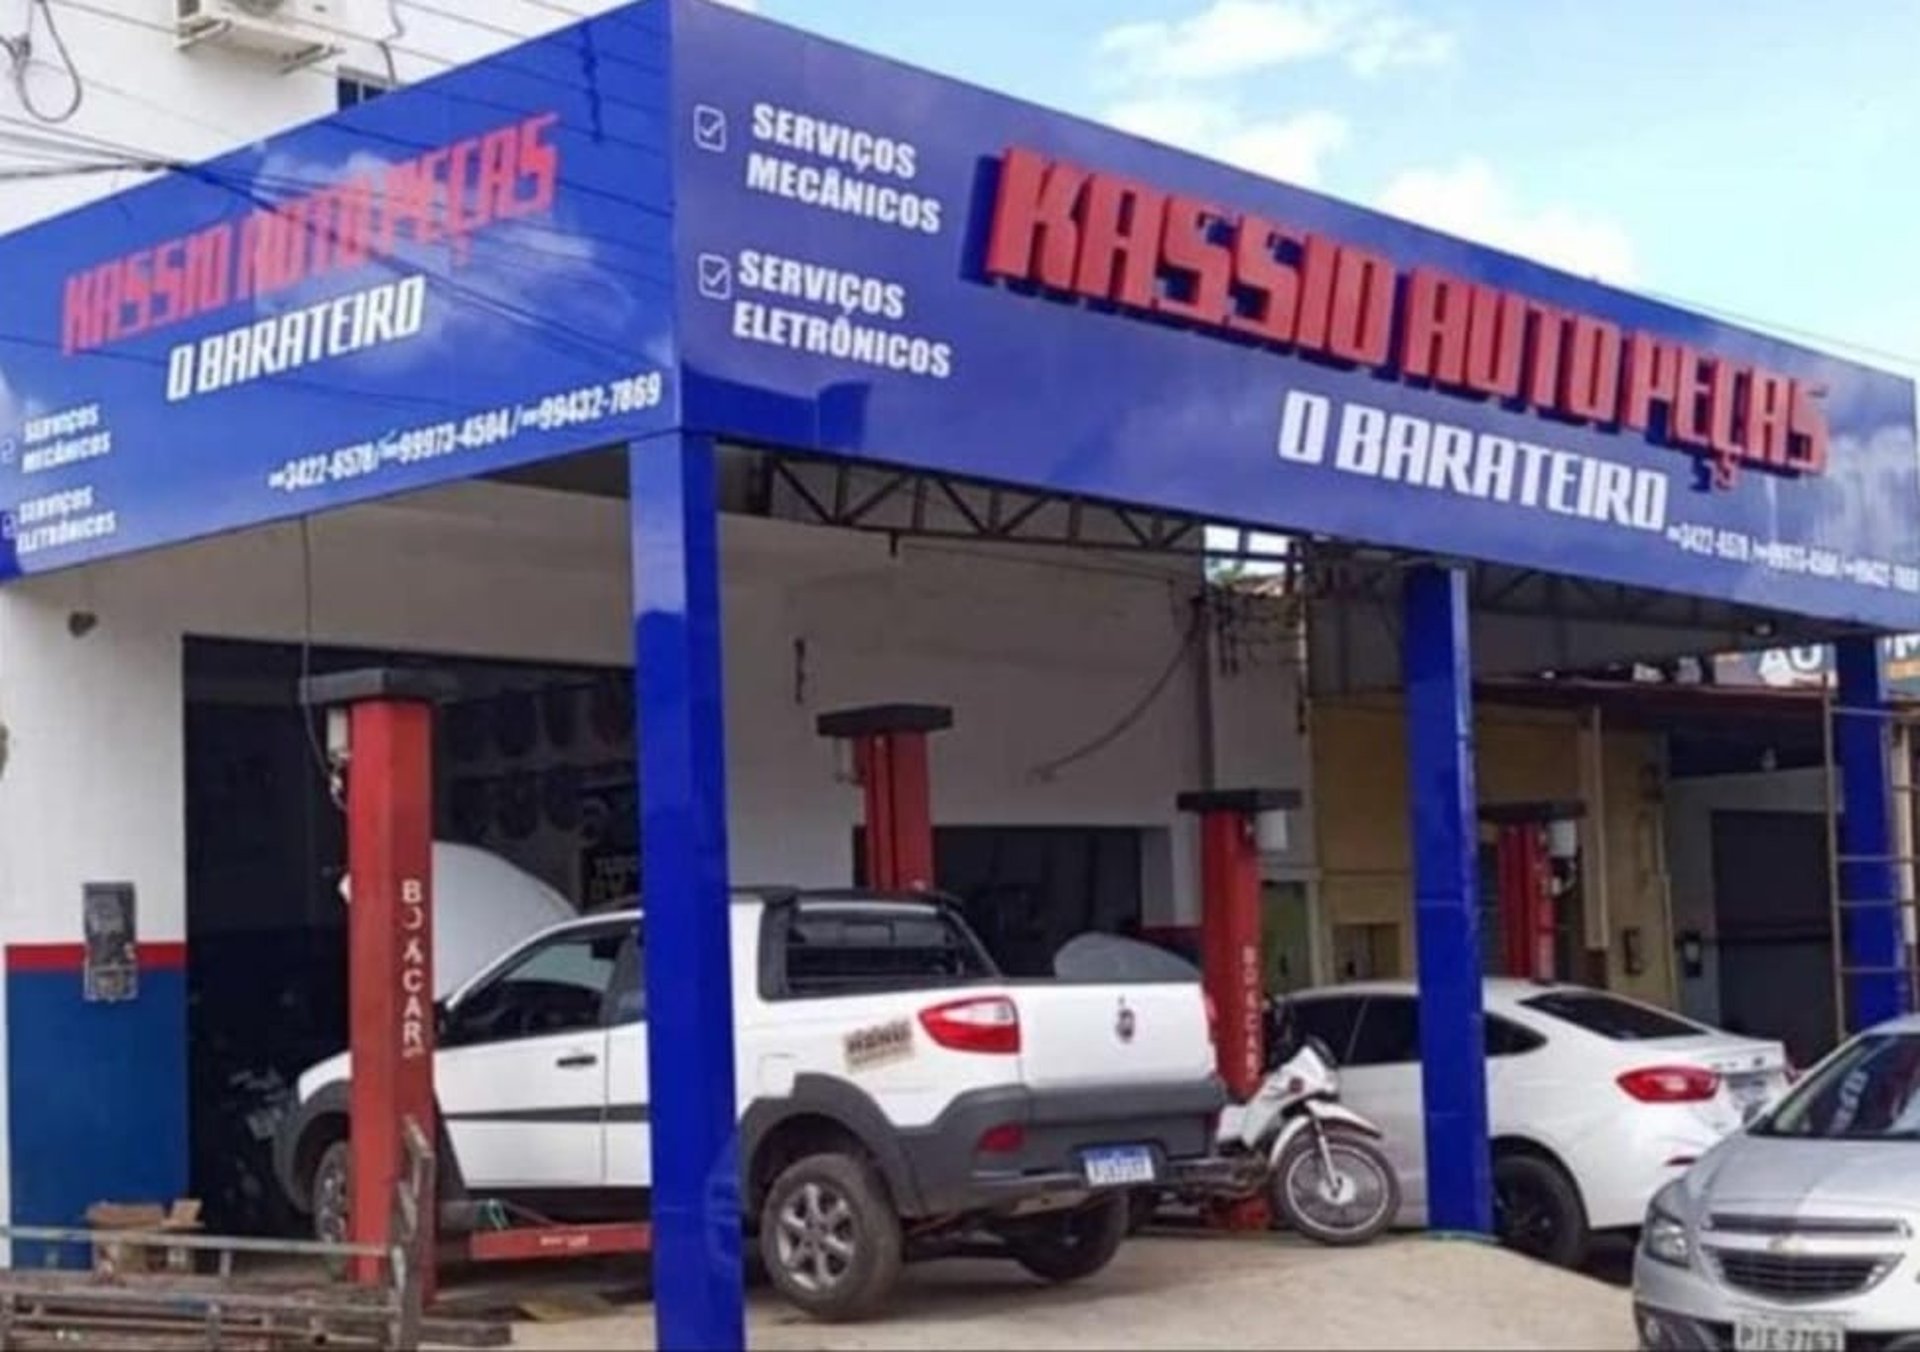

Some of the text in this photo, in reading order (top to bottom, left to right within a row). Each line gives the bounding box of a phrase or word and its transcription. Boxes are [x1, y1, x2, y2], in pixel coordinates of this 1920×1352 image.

[746, 153, 941, 233] MECÂNICOS
[752, 104, 917, 179] SERVIÇOS
[61, 223, 232, 357] KASSIO
[237, 174, 378, 300] AUTO
[738, 250, 905, 319] SERVIÇOS
[167, 275, 427, 401] O BARATEIRO
[733, 302, 952, 378] ELETRÔNICOS
[984, 147, 1831, 492] KASSIO AUTO PEÇAS
[1278, 390, 1668, 531] O BARATEIRO
